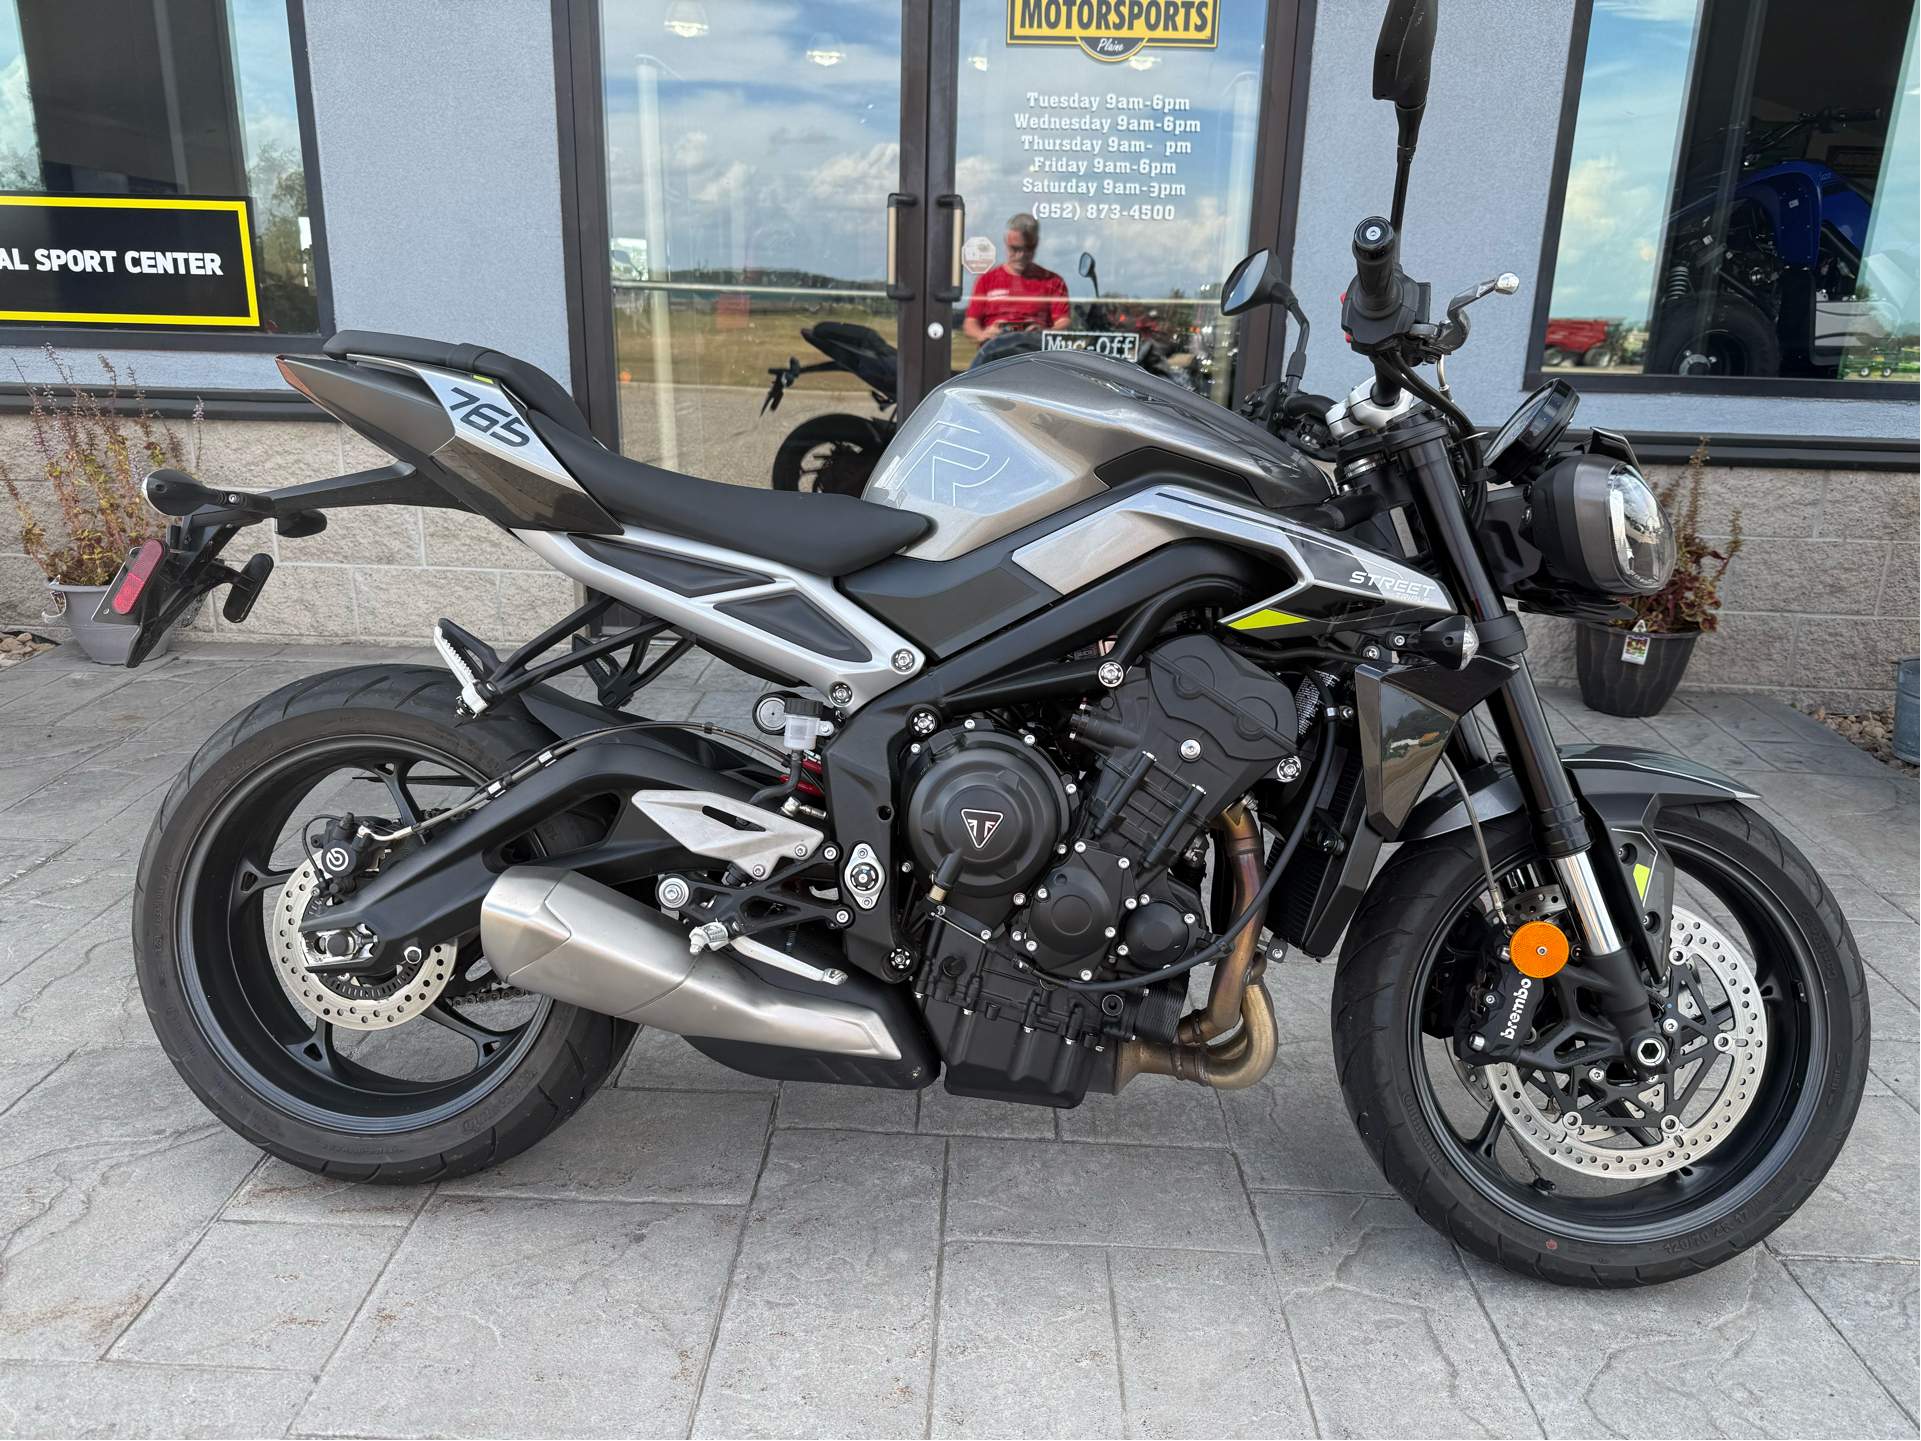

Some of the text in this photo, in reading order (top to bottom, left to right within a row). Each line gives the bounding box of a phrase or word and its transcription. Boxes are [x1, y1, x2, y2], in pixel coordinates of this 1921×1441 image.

[1020, 0, 1209, 33] MOTORSPORTS
[1026, 91, 1190, 113] Tuesday 9am-6pm
[1013, 113, 1201, 135] Wednesday 9am-6pm
[1021, 135, 1103, 155] Thursday
[1033, 156, 1177, 178] Friday 9am-6pm
[1022, 177, 1186, 199] Saturday 9am-3pm
[1031, 202, 1176, 221] (952) 873-4500
[34, 248, 117, 273] SPORT
[124, 250, 224, 276] CENTER
[449, 386, 531, 448] 765
[1349, 570, 1435, 597] STREET
[1500, 978, 1532, 1040] brembo
